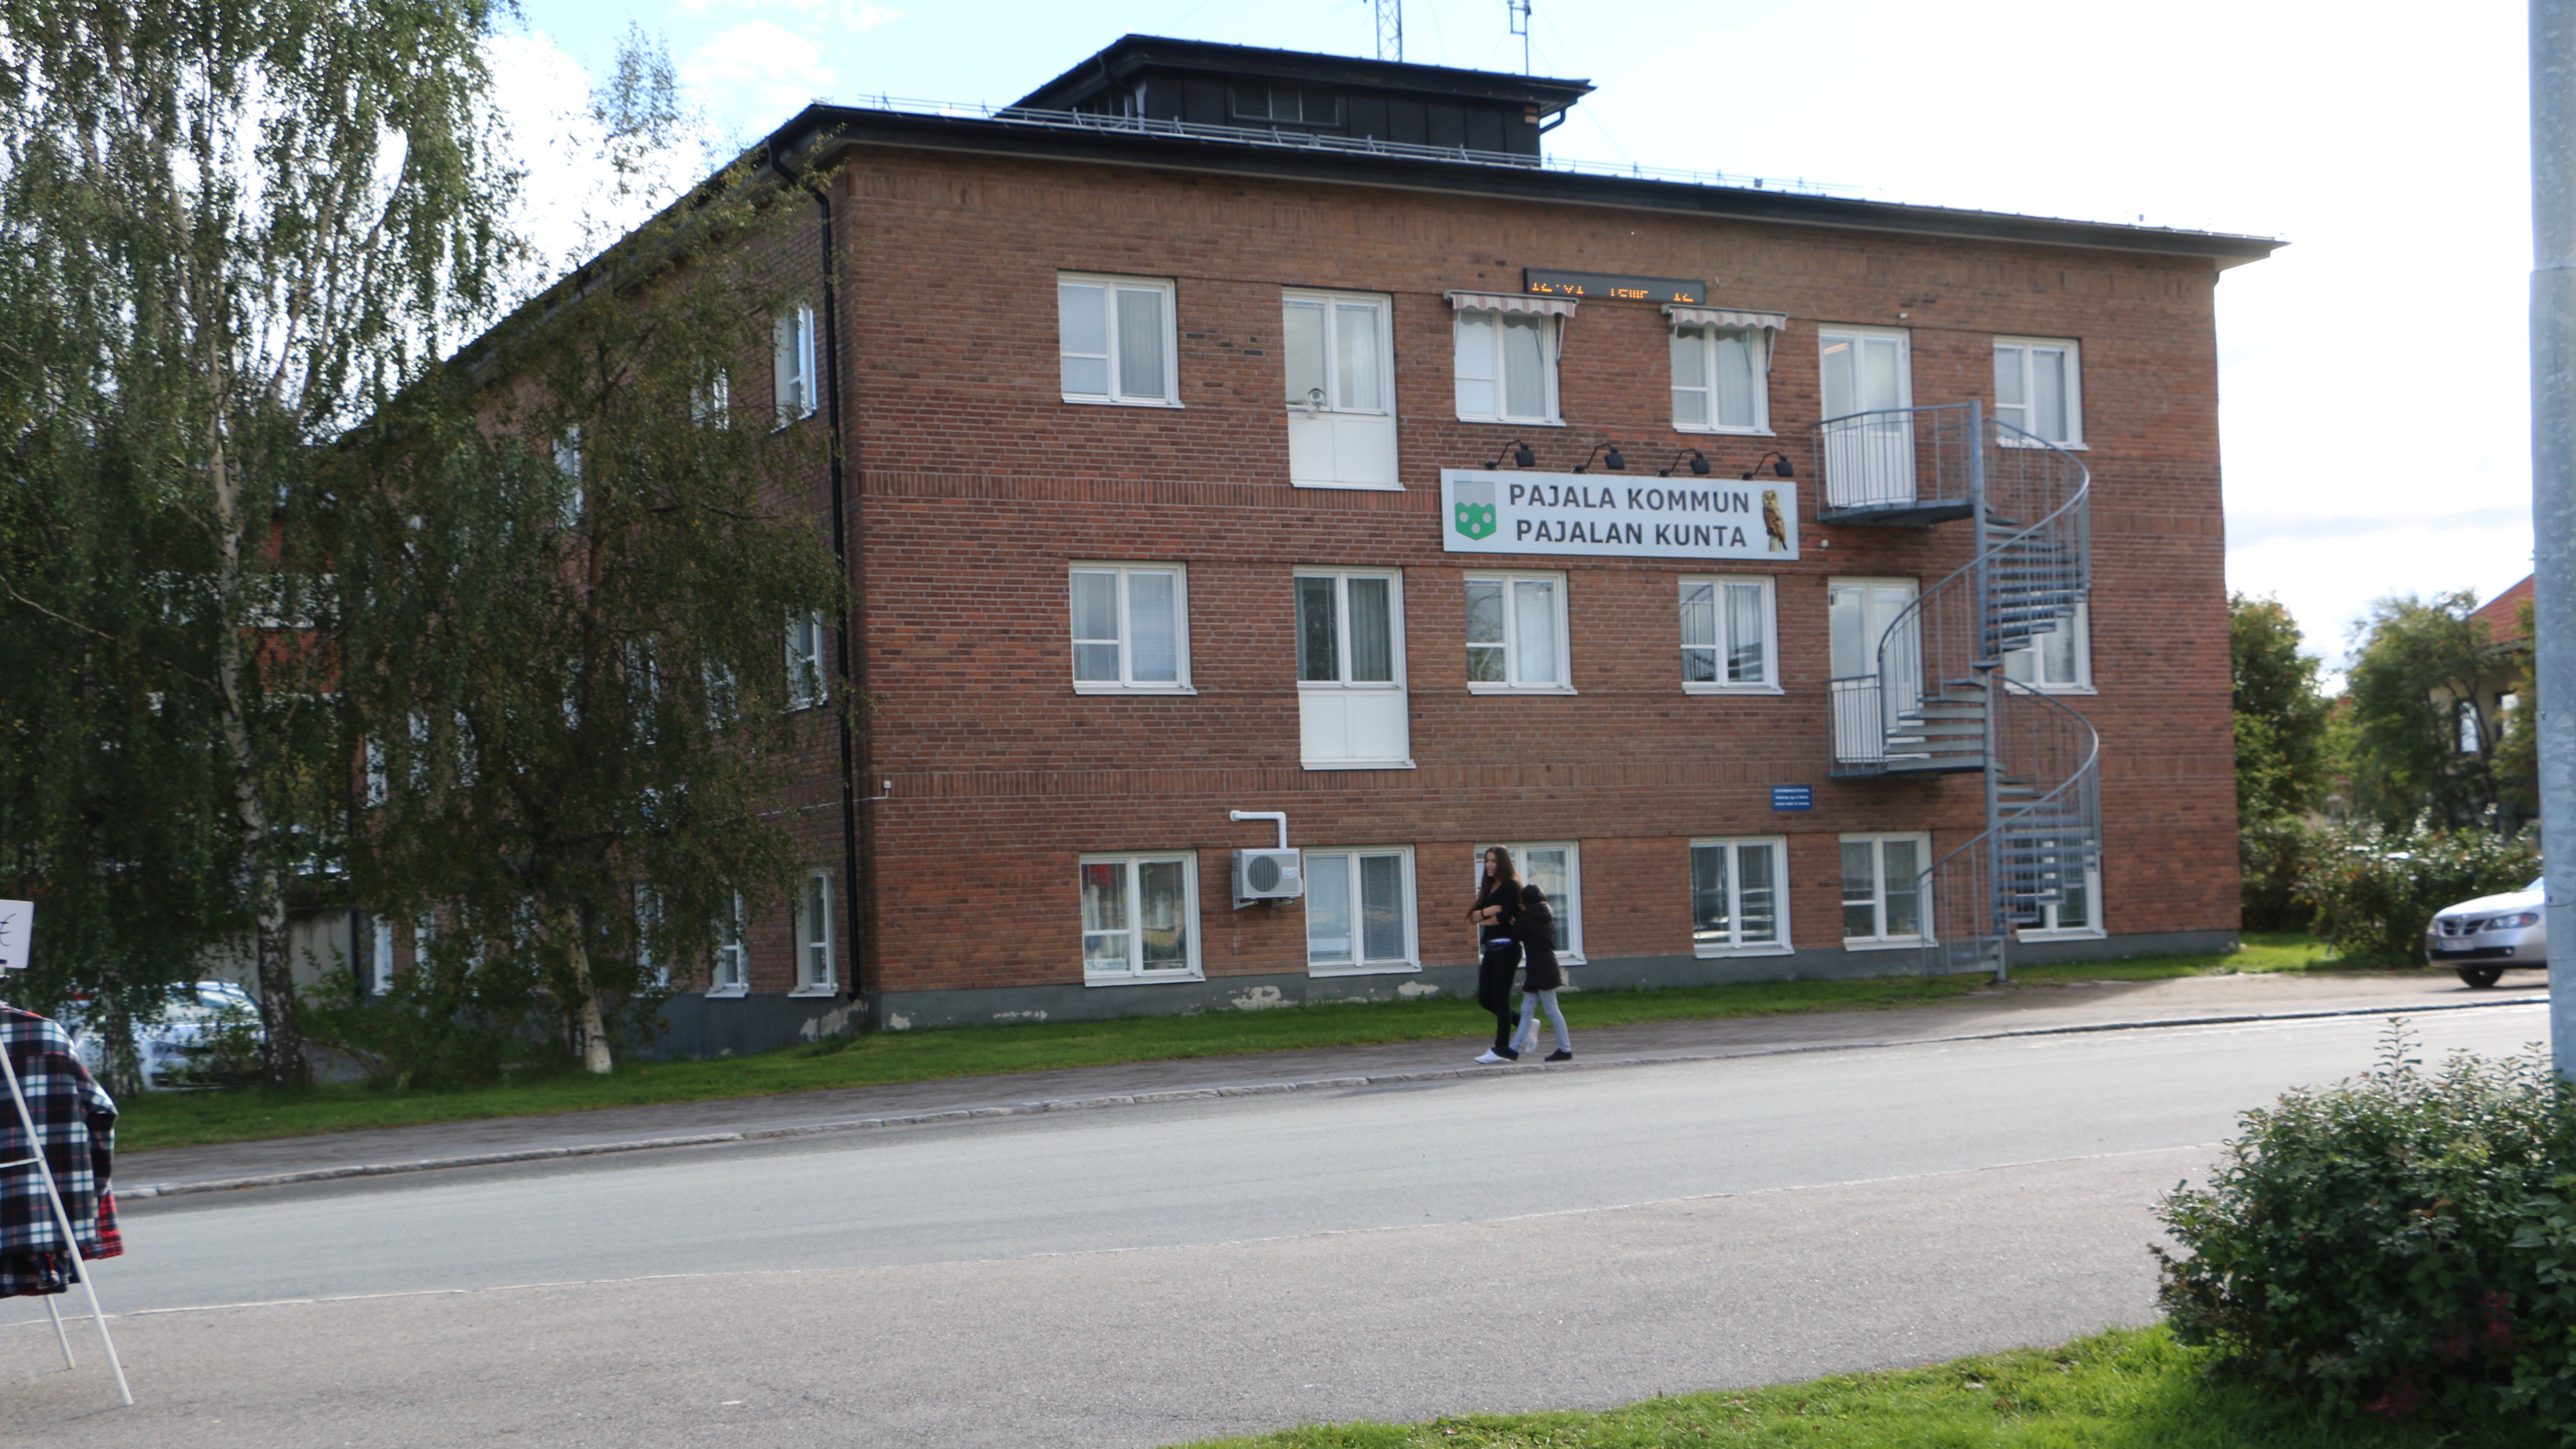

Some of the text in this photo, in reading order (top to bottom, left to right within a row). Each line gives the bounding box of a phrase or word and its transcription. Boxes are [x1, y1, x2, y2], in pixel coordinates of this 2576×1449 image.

[1510, 484, 1748, 513] PAJALA KOMMUN
[1517, 520, 1747, 547] PAJALAN KUNTA
